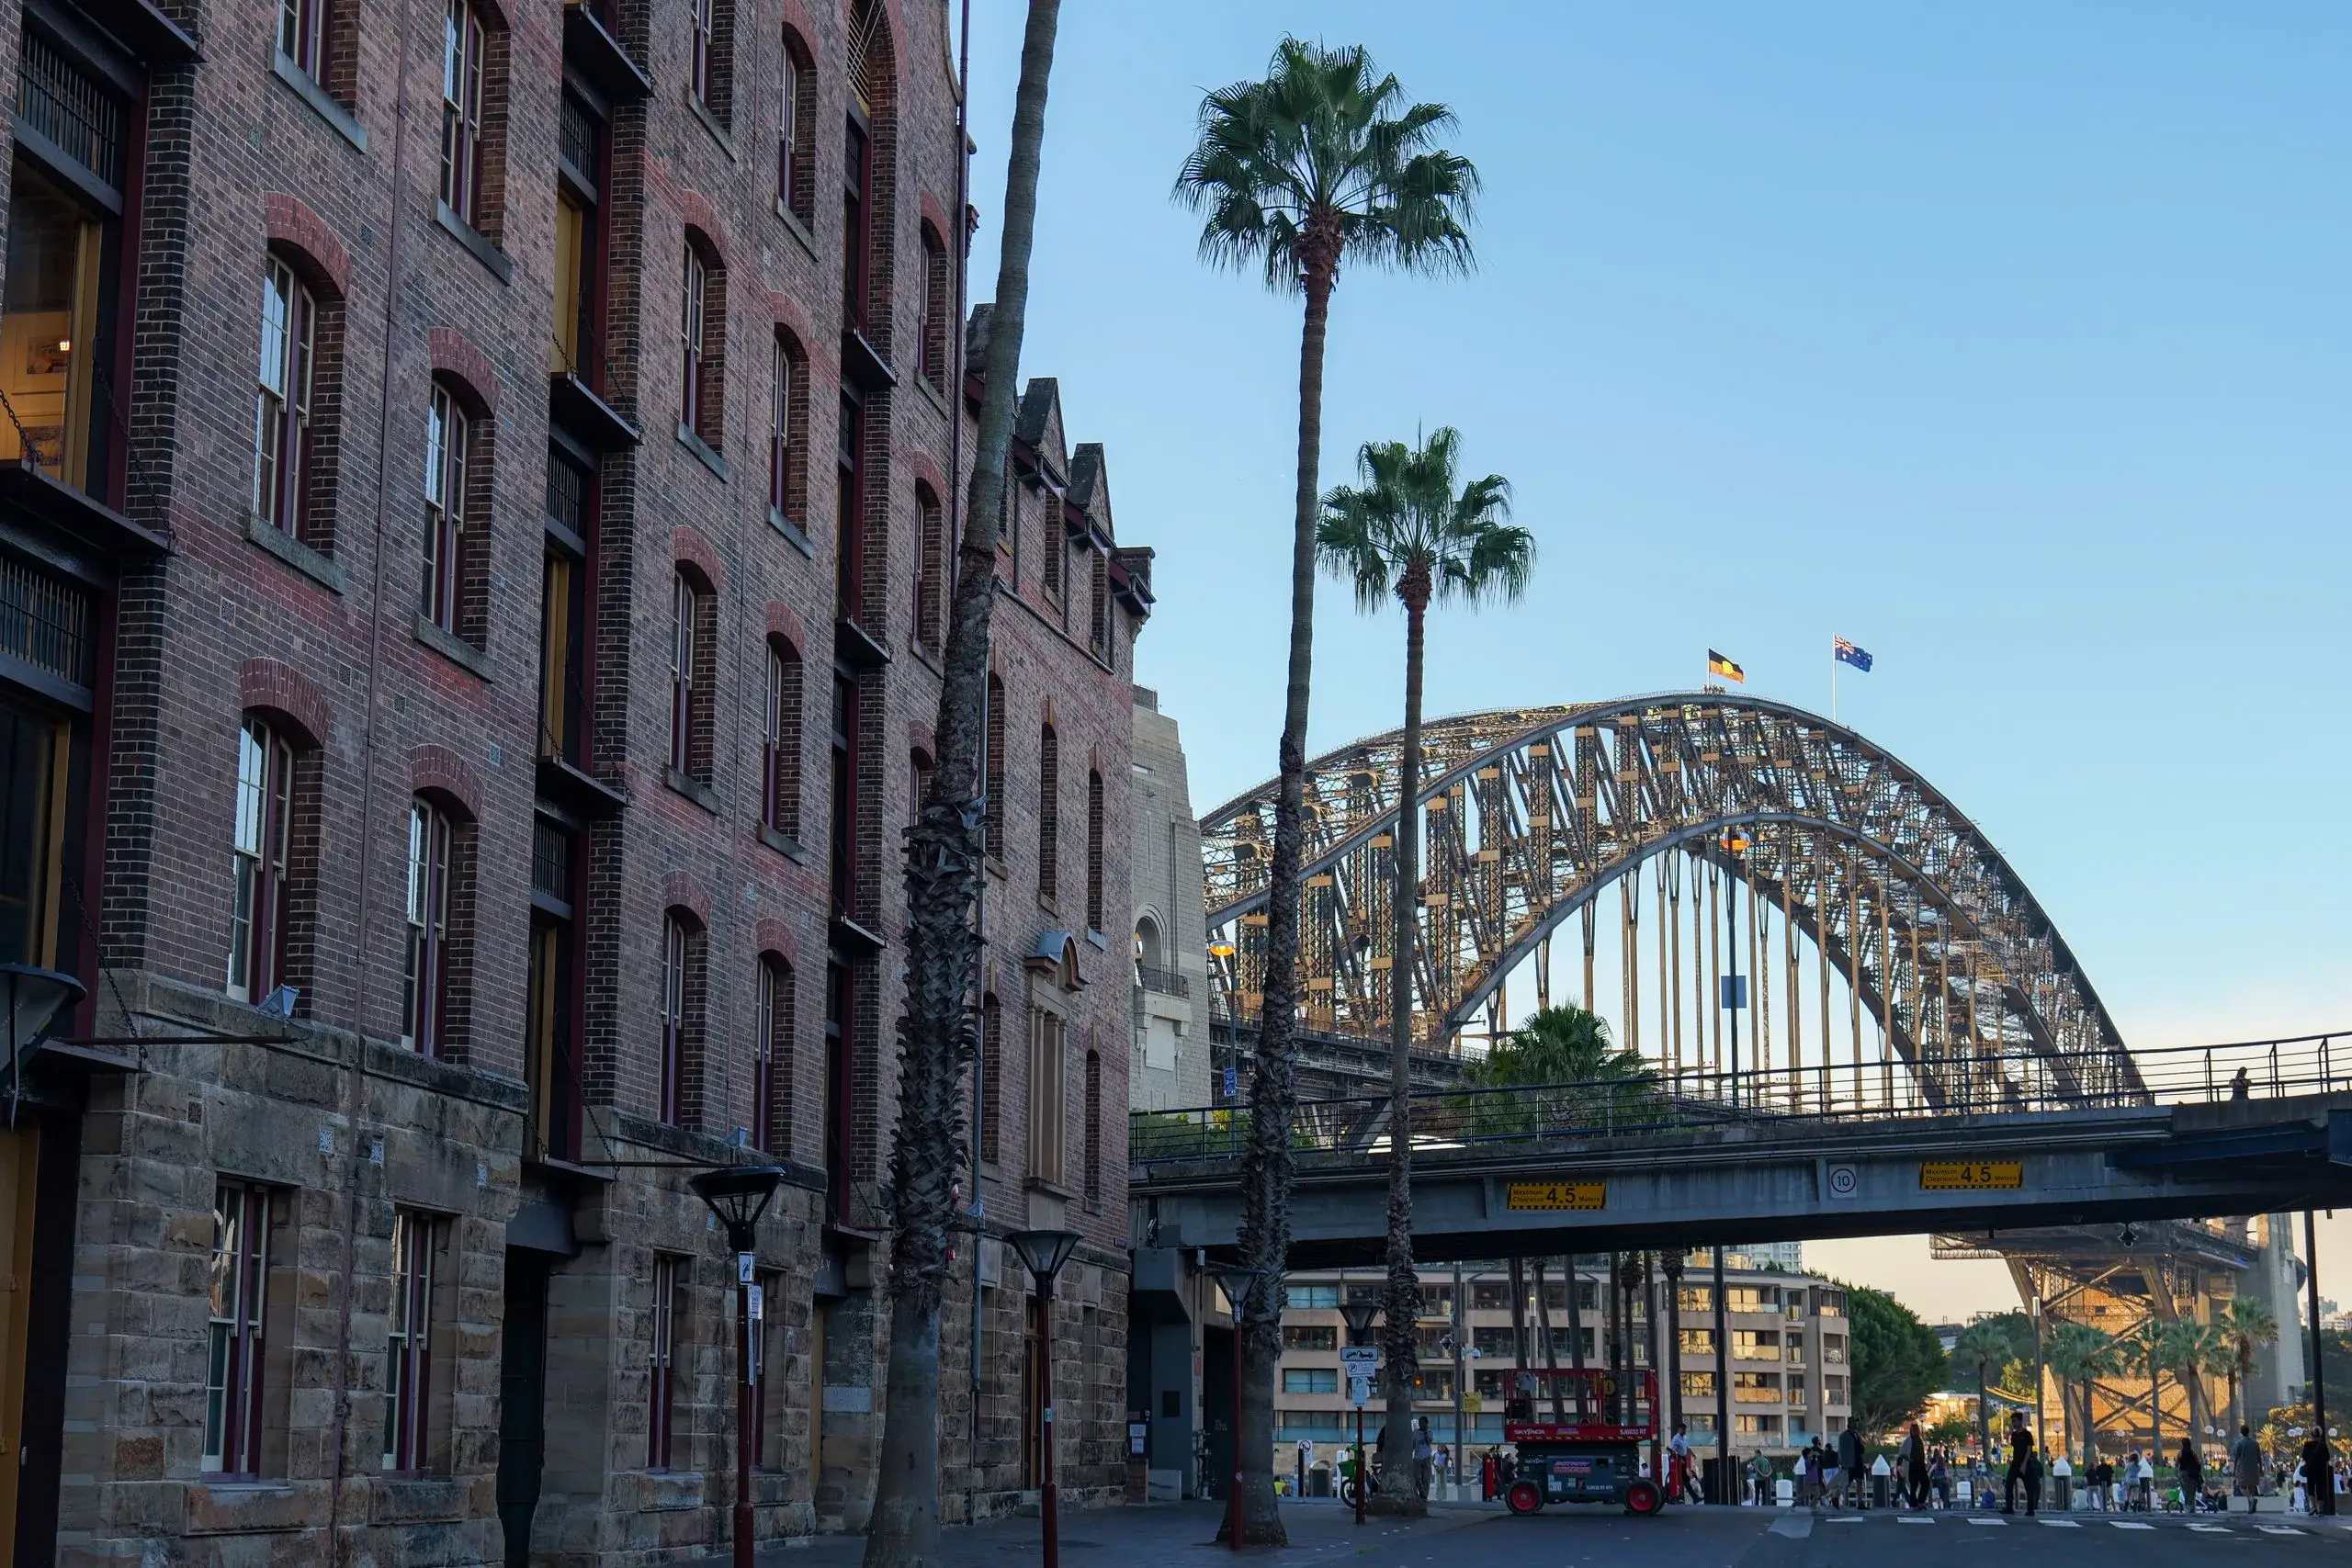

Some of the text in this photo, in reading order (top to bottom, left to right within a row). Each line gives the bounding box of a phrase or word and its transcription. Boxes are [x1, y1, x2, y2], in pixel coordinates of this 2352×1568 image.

[1838, 1176, 1850, 1187] 10
[1961, 1167, 1991, 1182] 4.5
[1546, 1188, 1576, 1203] 4.5
